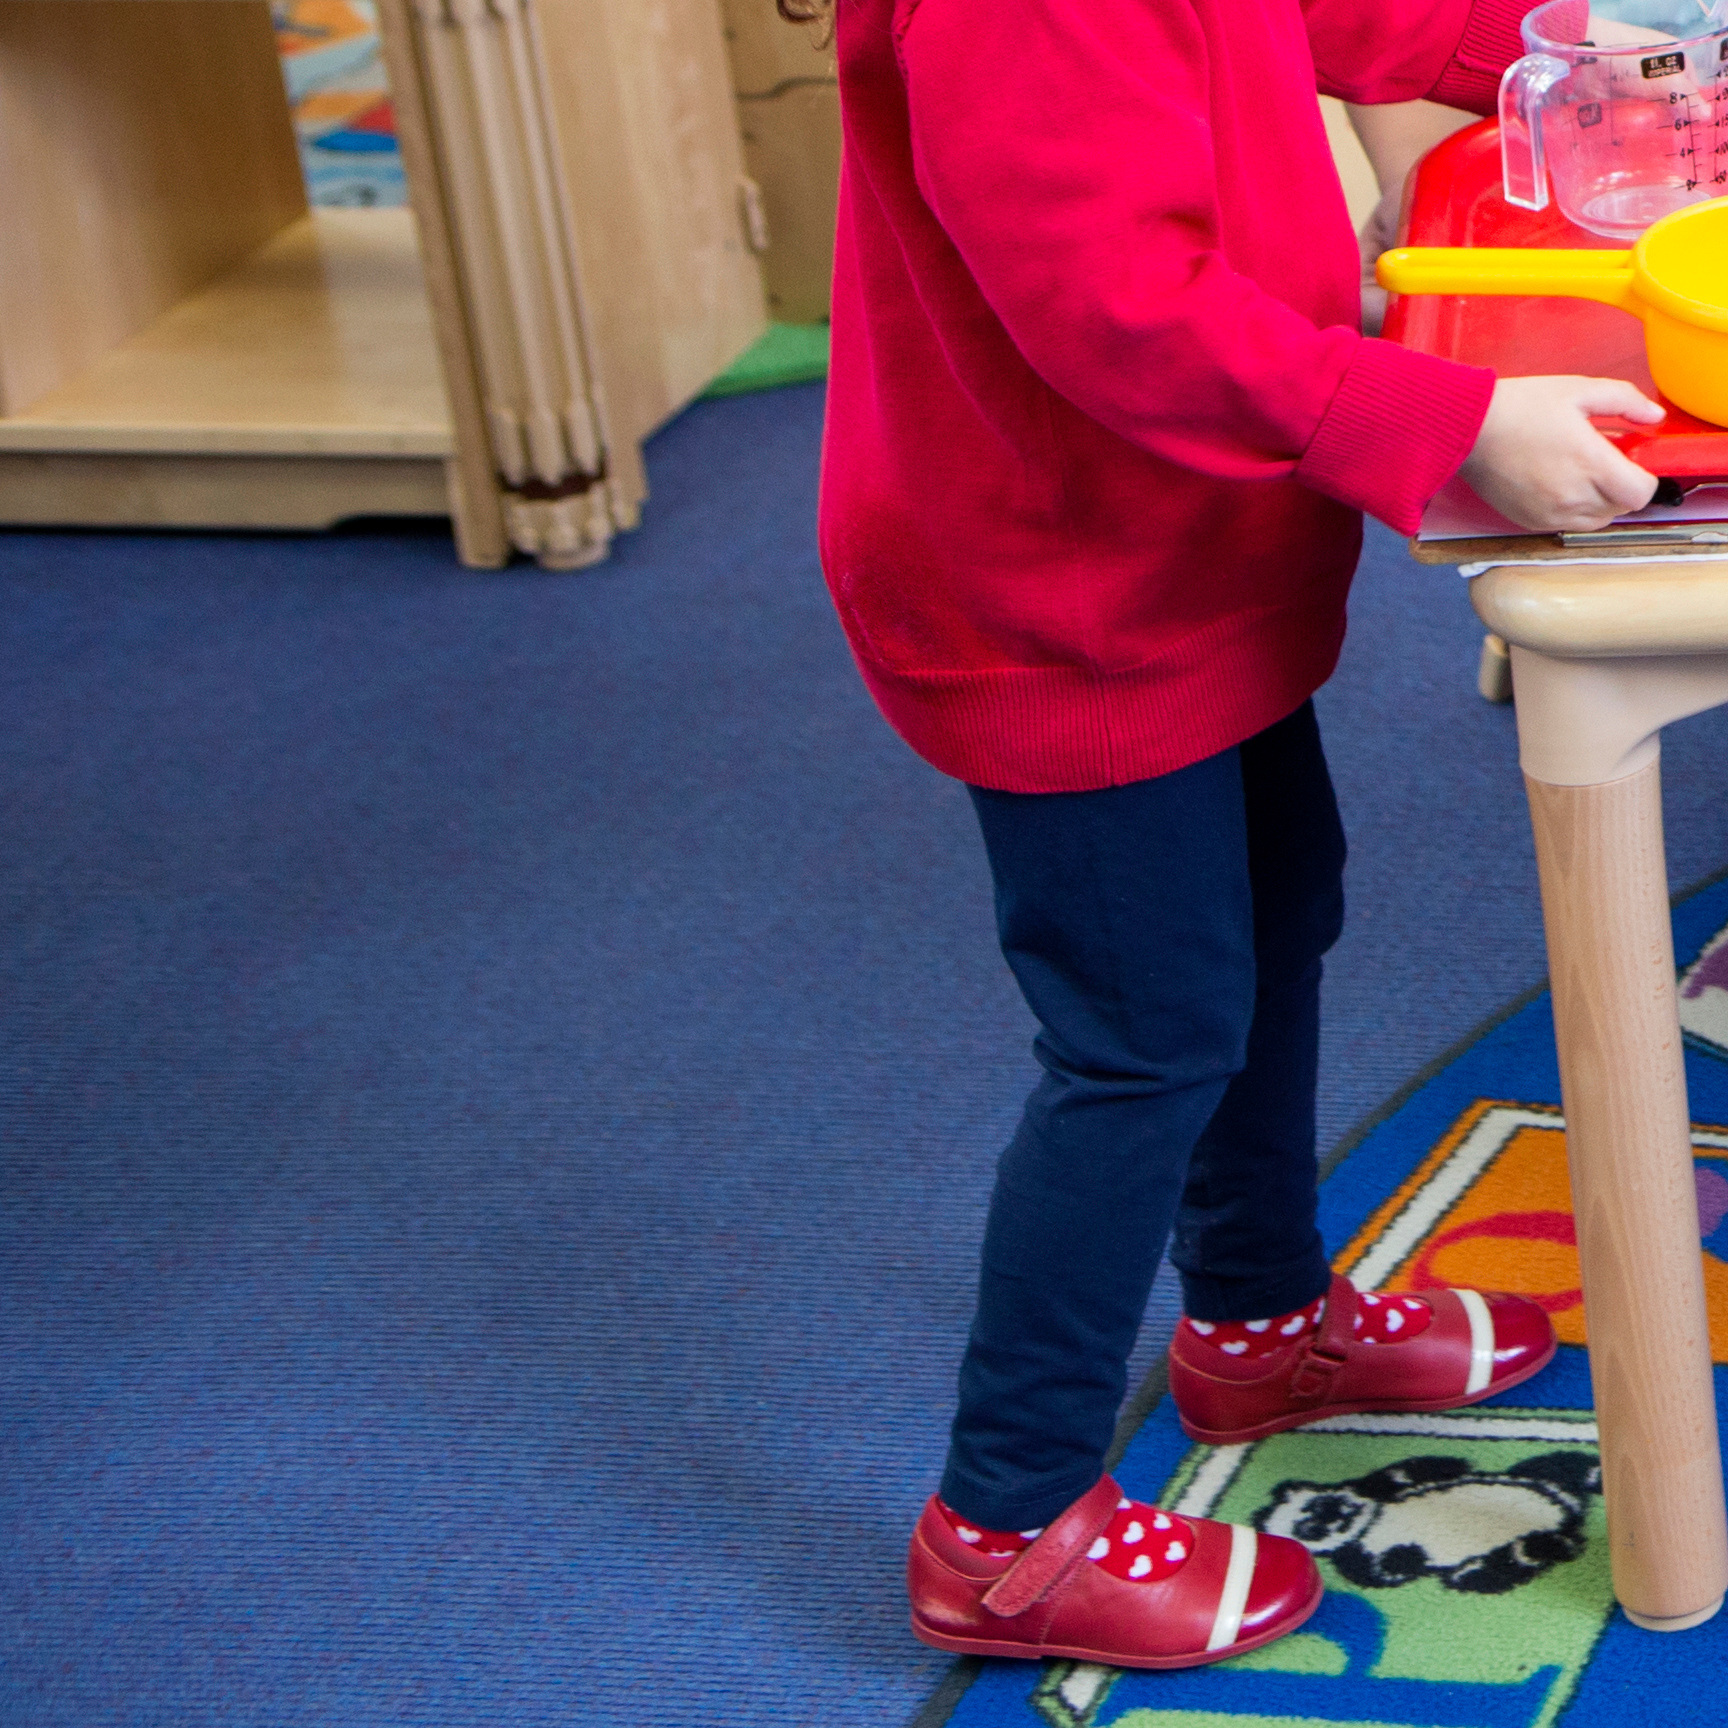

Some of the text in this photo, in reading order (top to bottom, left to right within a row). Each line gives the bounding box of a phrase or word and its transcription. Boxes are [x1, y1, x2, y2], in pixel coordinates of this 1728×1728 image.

[1669, 92, 1678, 105] 8
[1674, 119, 1682, 131] 6
[1680, 147, 1686, 158] 4
